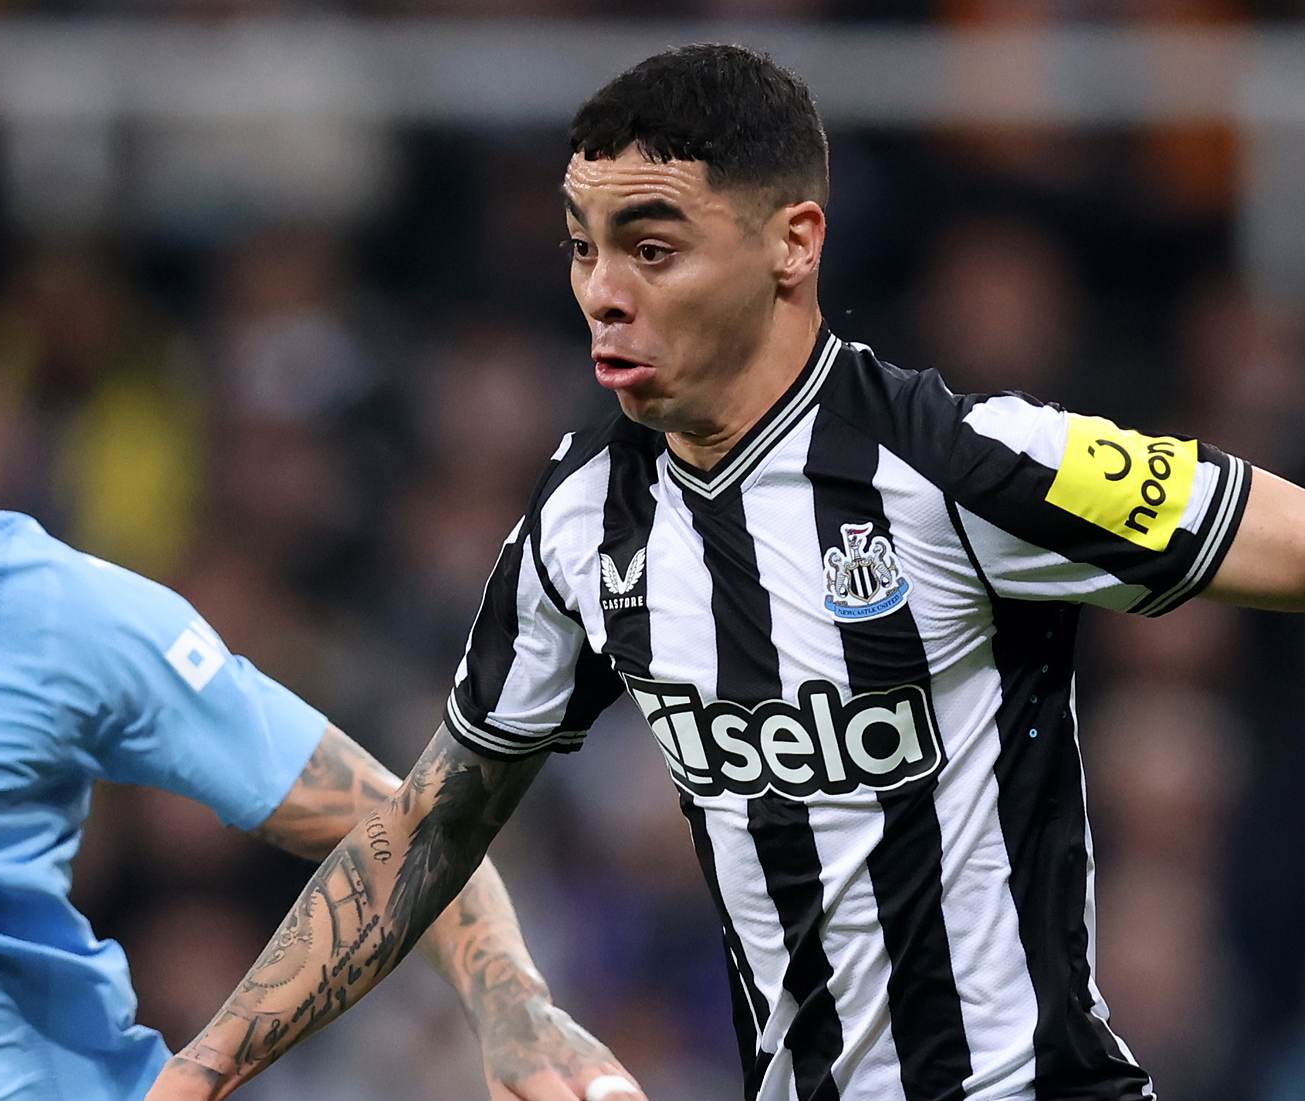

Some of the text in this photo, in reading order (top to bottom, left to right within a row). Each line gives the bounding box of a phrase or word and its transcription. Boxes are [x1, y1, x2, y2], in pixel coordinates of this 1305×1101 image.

[1124, 442, 1175, 535] noon
[602, 595, 644, 610] CASTORE
[837, 606, 877, 616] NEWCASTLE
